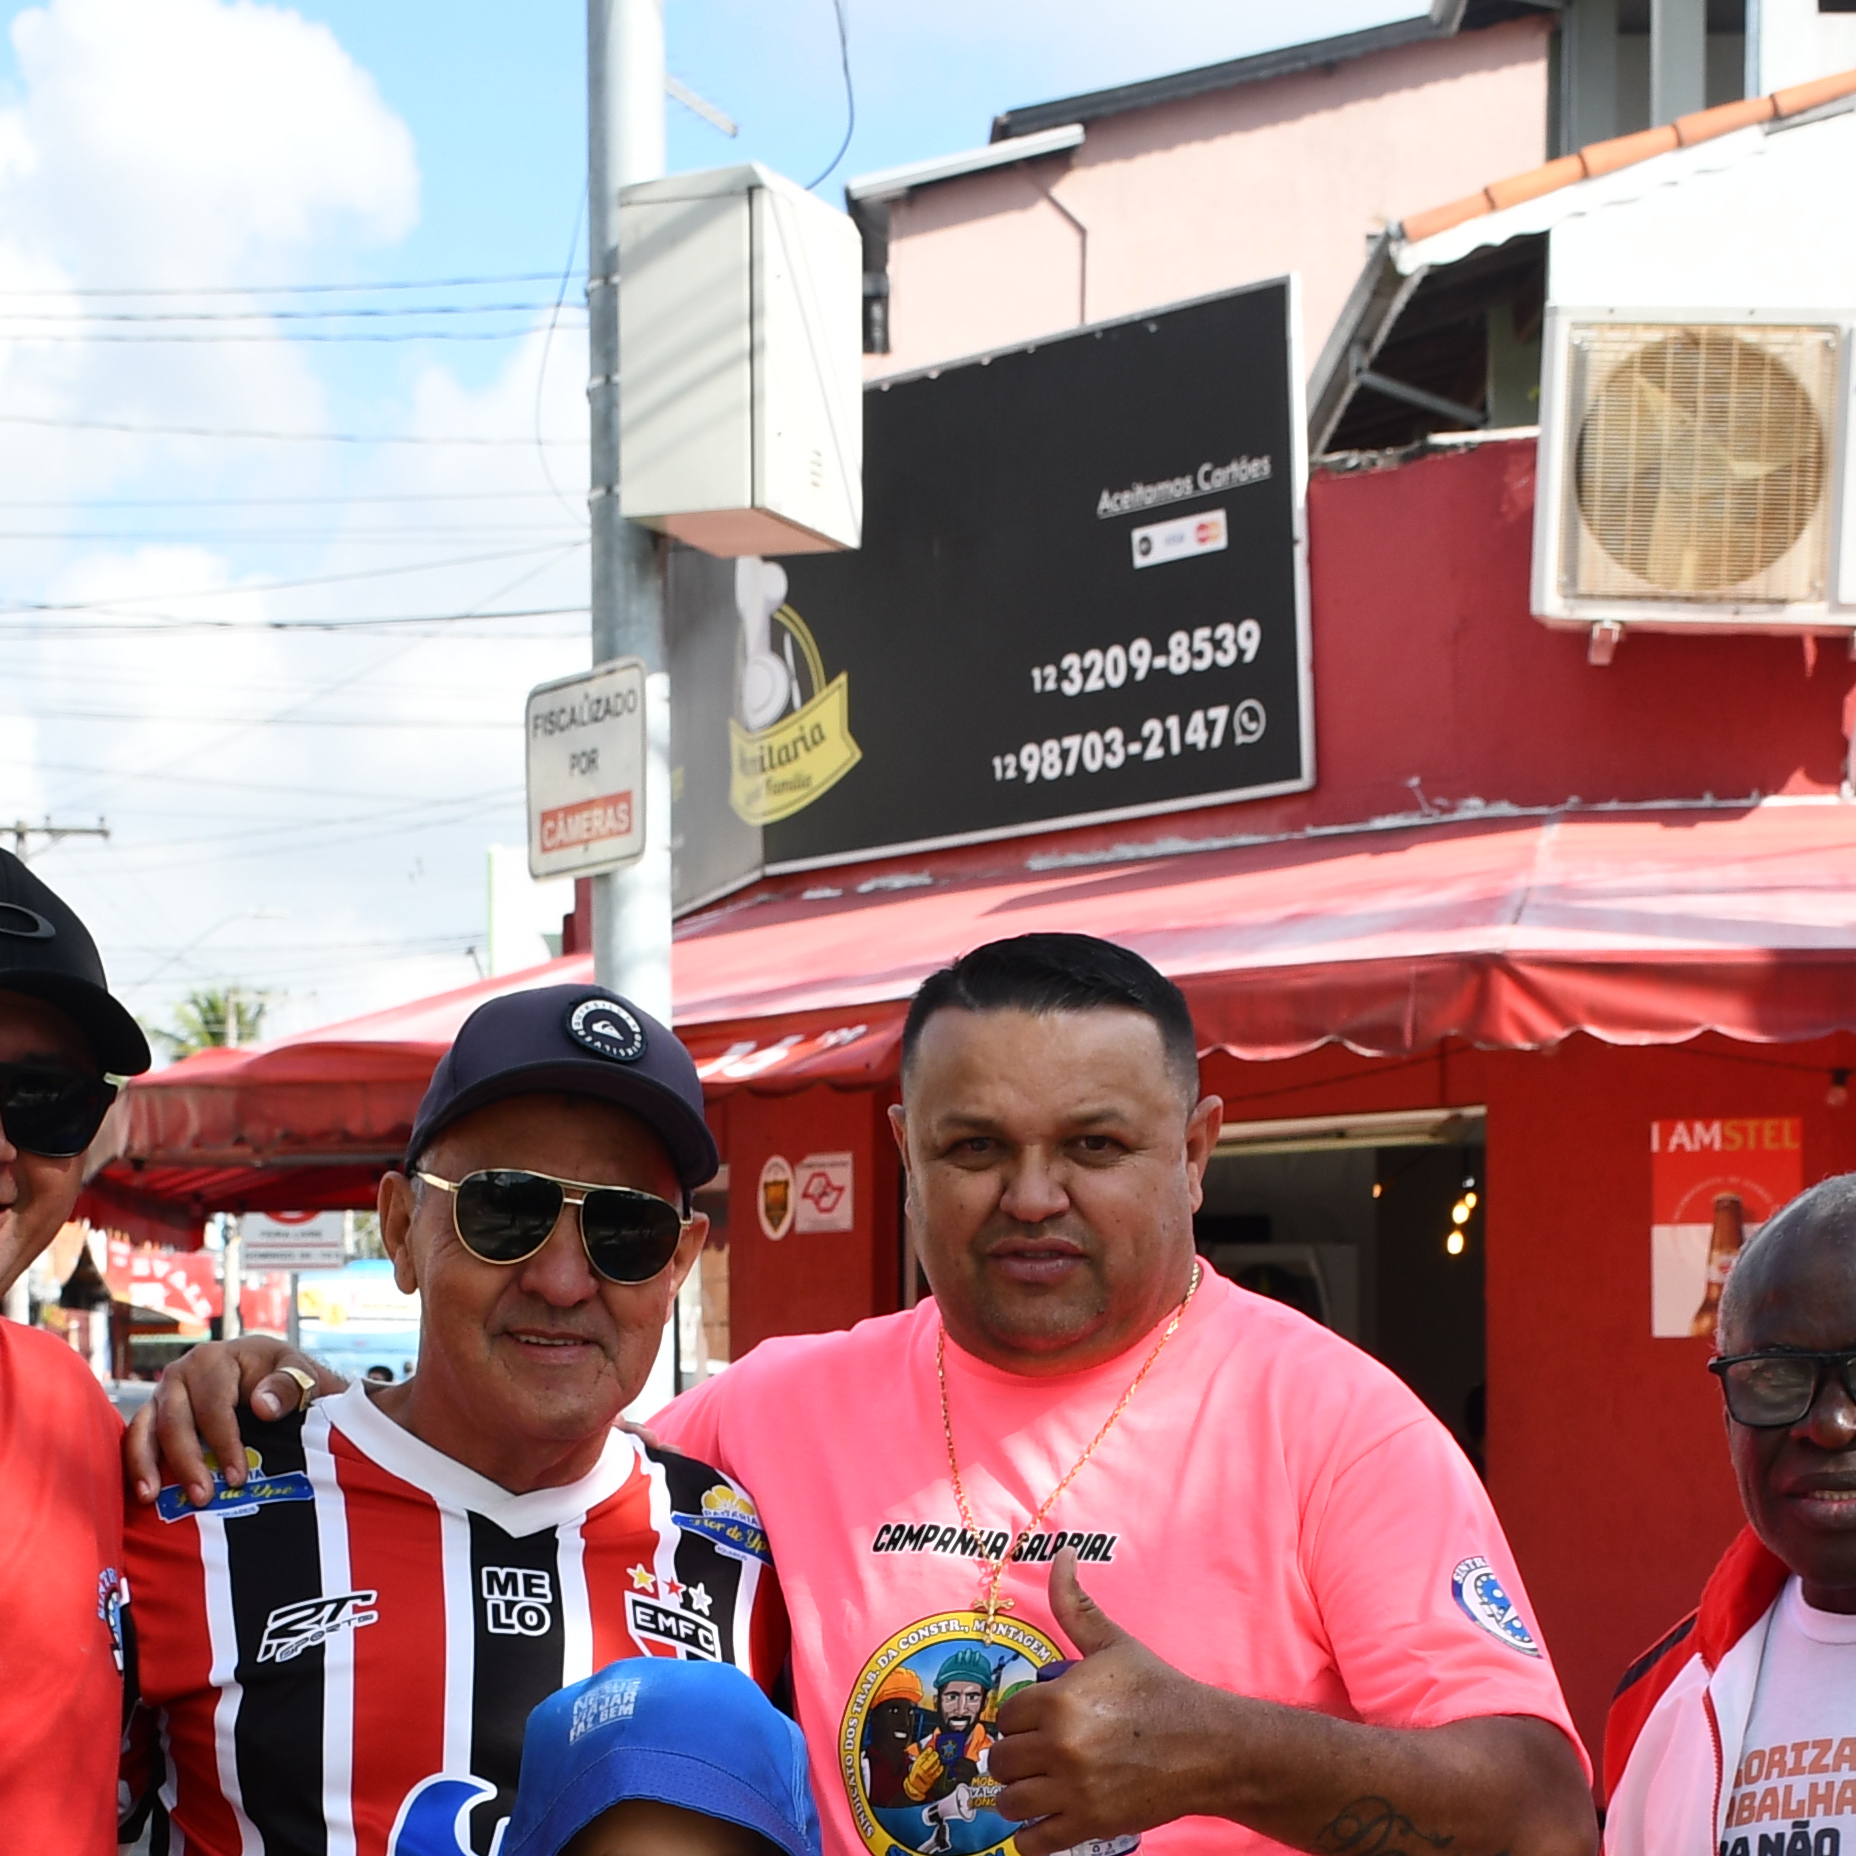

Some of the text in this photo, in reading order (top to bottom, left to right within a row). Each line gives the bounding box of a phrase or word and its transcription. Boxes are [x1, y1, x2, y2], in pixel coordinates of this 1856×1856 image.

[1096, 454, 1272, 517] Aceitamos Cartões
[1031, 618, 1261, 697] 12 3209-8539
[533, 689, 637, 739] FISCALIZADO
[569, 749, 600, 777] POR
[992, 704, 1230, 784] 12 98703-2147
[1651, 1119, 1800, 1153] I AMSTEL
[744, 1529, 768, 1555] Yp
[872, 1523, 1010, 1561] CAMPANHA
[487, 1599, 551, 1636] LO
[635, 1605, 716, 1652] EMFC
[877, 1645, 899, 1668] DA
[852, 1670, 881, 1714] TRAB.
[844, 1716, 859, 1751] DOS
[844, 1753, 875, 1838] SINDICATO
